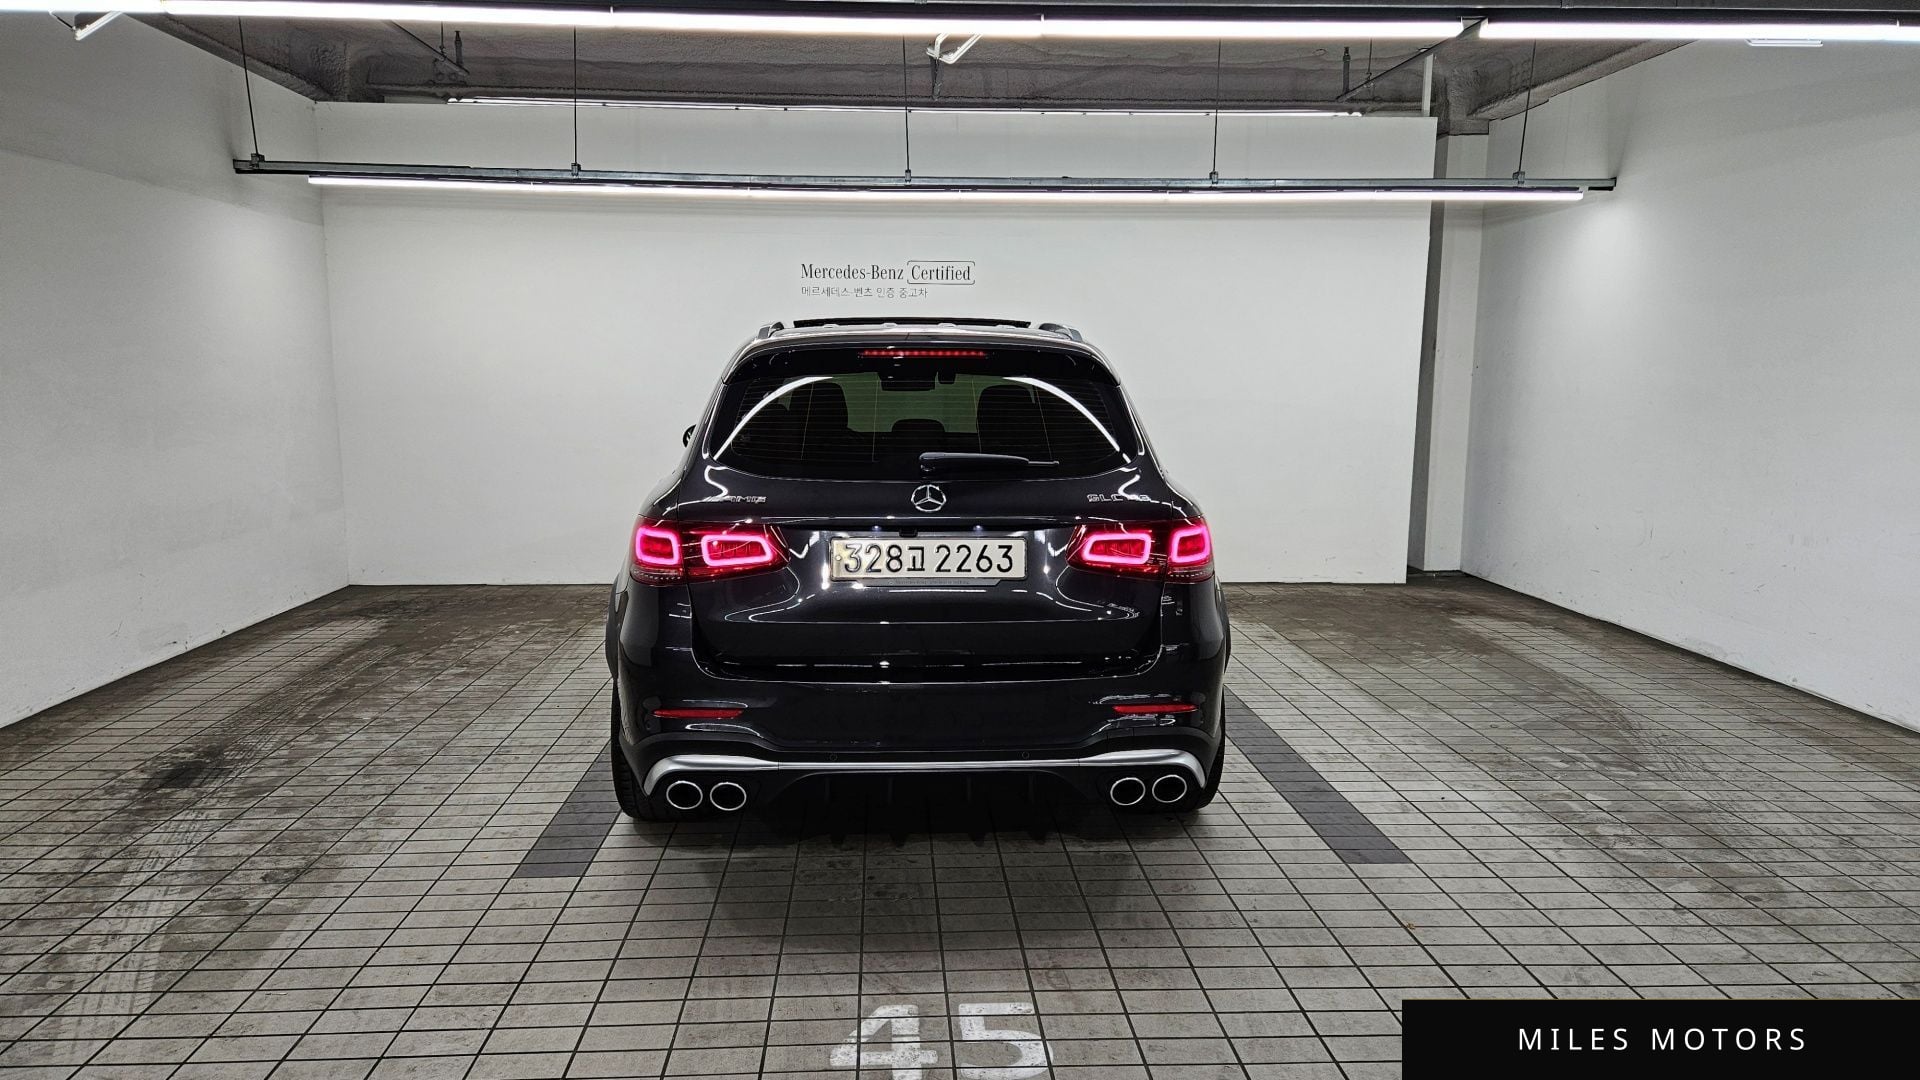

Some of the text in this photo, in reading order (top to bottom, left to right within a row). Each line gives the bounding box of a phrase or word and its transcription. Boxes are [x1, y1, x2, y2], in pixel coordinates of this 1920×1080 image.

[801, 263, 971, 281] Mercedes-Benz Certified
[876, 287, 895, 299] 인증
[898, 287, 928, 299] 중고차
[844, 544, 1013, 573] 328고 2263
[829, 1002, 1054, 1080] 45
